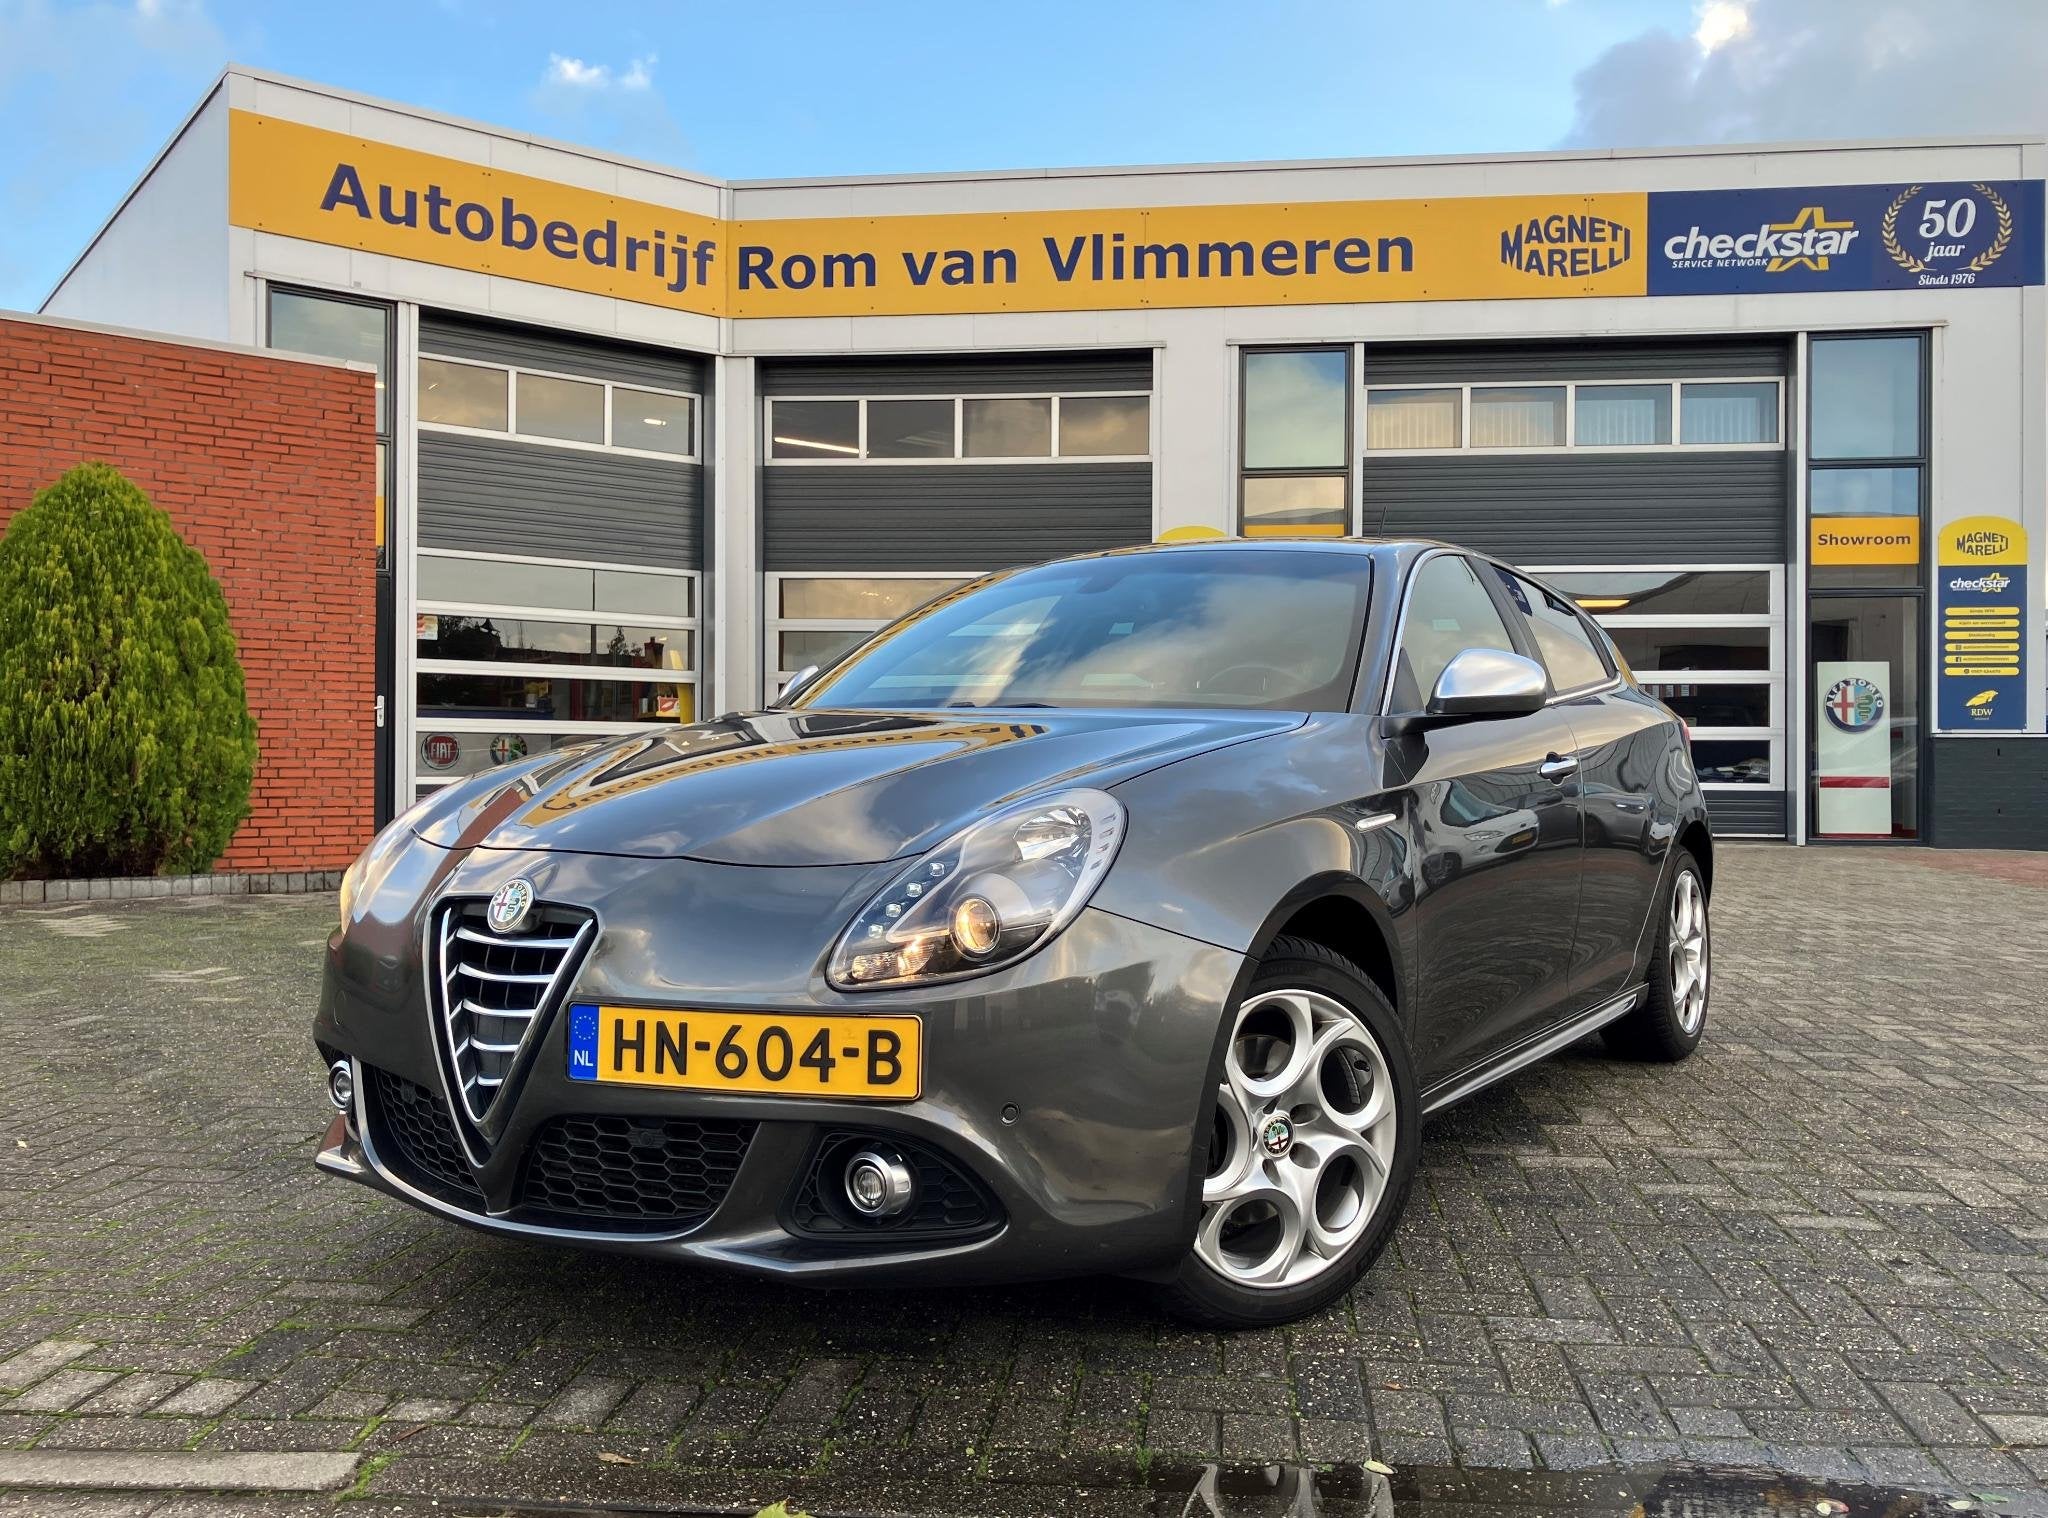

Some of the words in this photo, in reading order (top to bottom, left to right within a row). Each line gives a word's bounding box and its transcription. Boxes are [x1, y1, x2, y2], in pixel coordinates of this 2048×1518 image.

[320, 162, 717, 293] Autobedrijf
[737, 245, 878, 290] Rom
[901, 247, 1017, 286] van
[1042, 232, 1414, 283] Vlimmeren
[1918, 198, 1977, 238] 50
[1500, 214, 1631, 263] MAGNETI
[1664, 225, 1860, 260] checkstar
[1500, 231, 1631, 278] MARELLI
[1923, 241, 1966, 262] jaar
[1672, 257, 1713, 269] SERVICE
[1716, 257, 1769, 268] NETWORK
[1918, 273, 1949, 286] Sinds
[1950, 272, 1976, 285] 1976
[1817, 532, 1912, 547] Showroom
[1956, 531, 2009, 550] MAGNETI
[1956, 537, 2009, 556] MARELLI
[1949, 577, 2011, 589] checkstar
[1826, 681, 1847, 708] ALFA
[1849, 678, 1884, 708] ROMEO
[1970, 708, 1993, 716] RDW
[430, 741, 454, 759] FIAT
[573, 1050, 594, 1068] NL
[613, 1018, 903, 1086] HN-604-B
